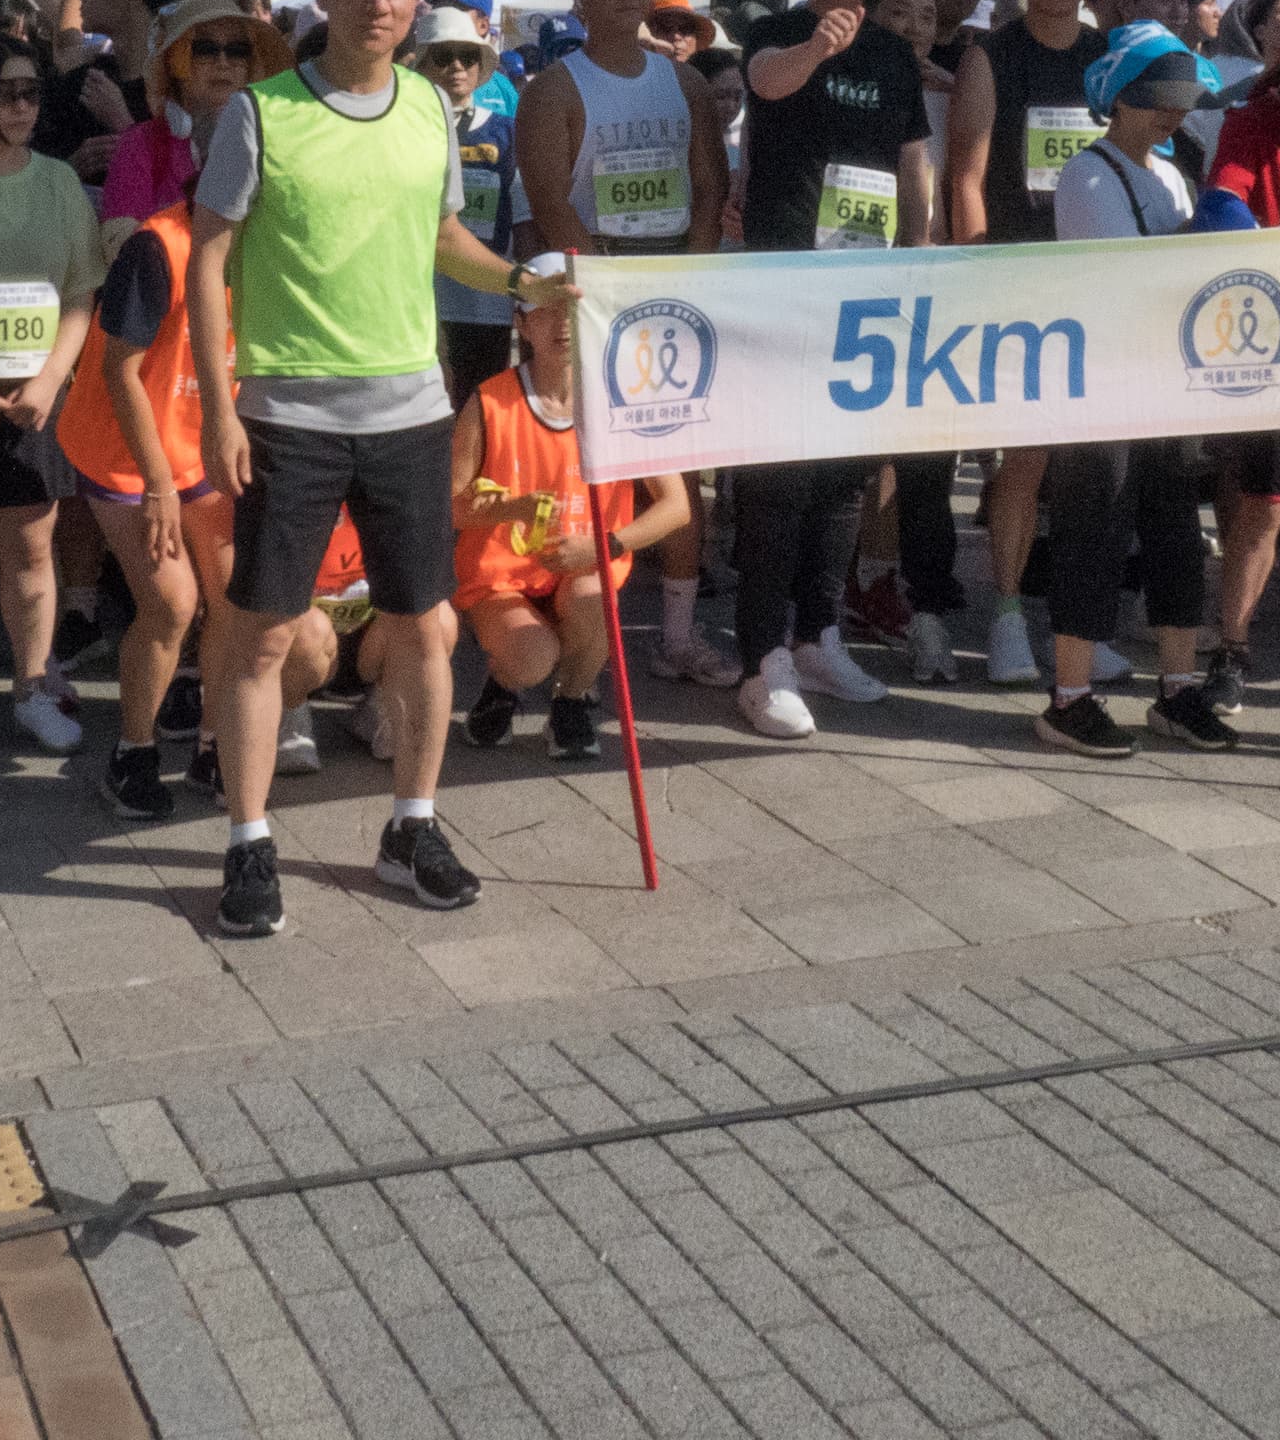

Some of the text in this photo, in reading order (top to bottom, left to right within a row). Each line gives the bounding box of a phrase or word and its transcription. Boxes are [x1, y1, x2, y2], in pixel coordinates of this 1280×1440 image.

[611, 178, 669, 205] 6904
[828, 296, 1086, 412] 5km
[624, 403, 692, 424] 어울림 마라톤
